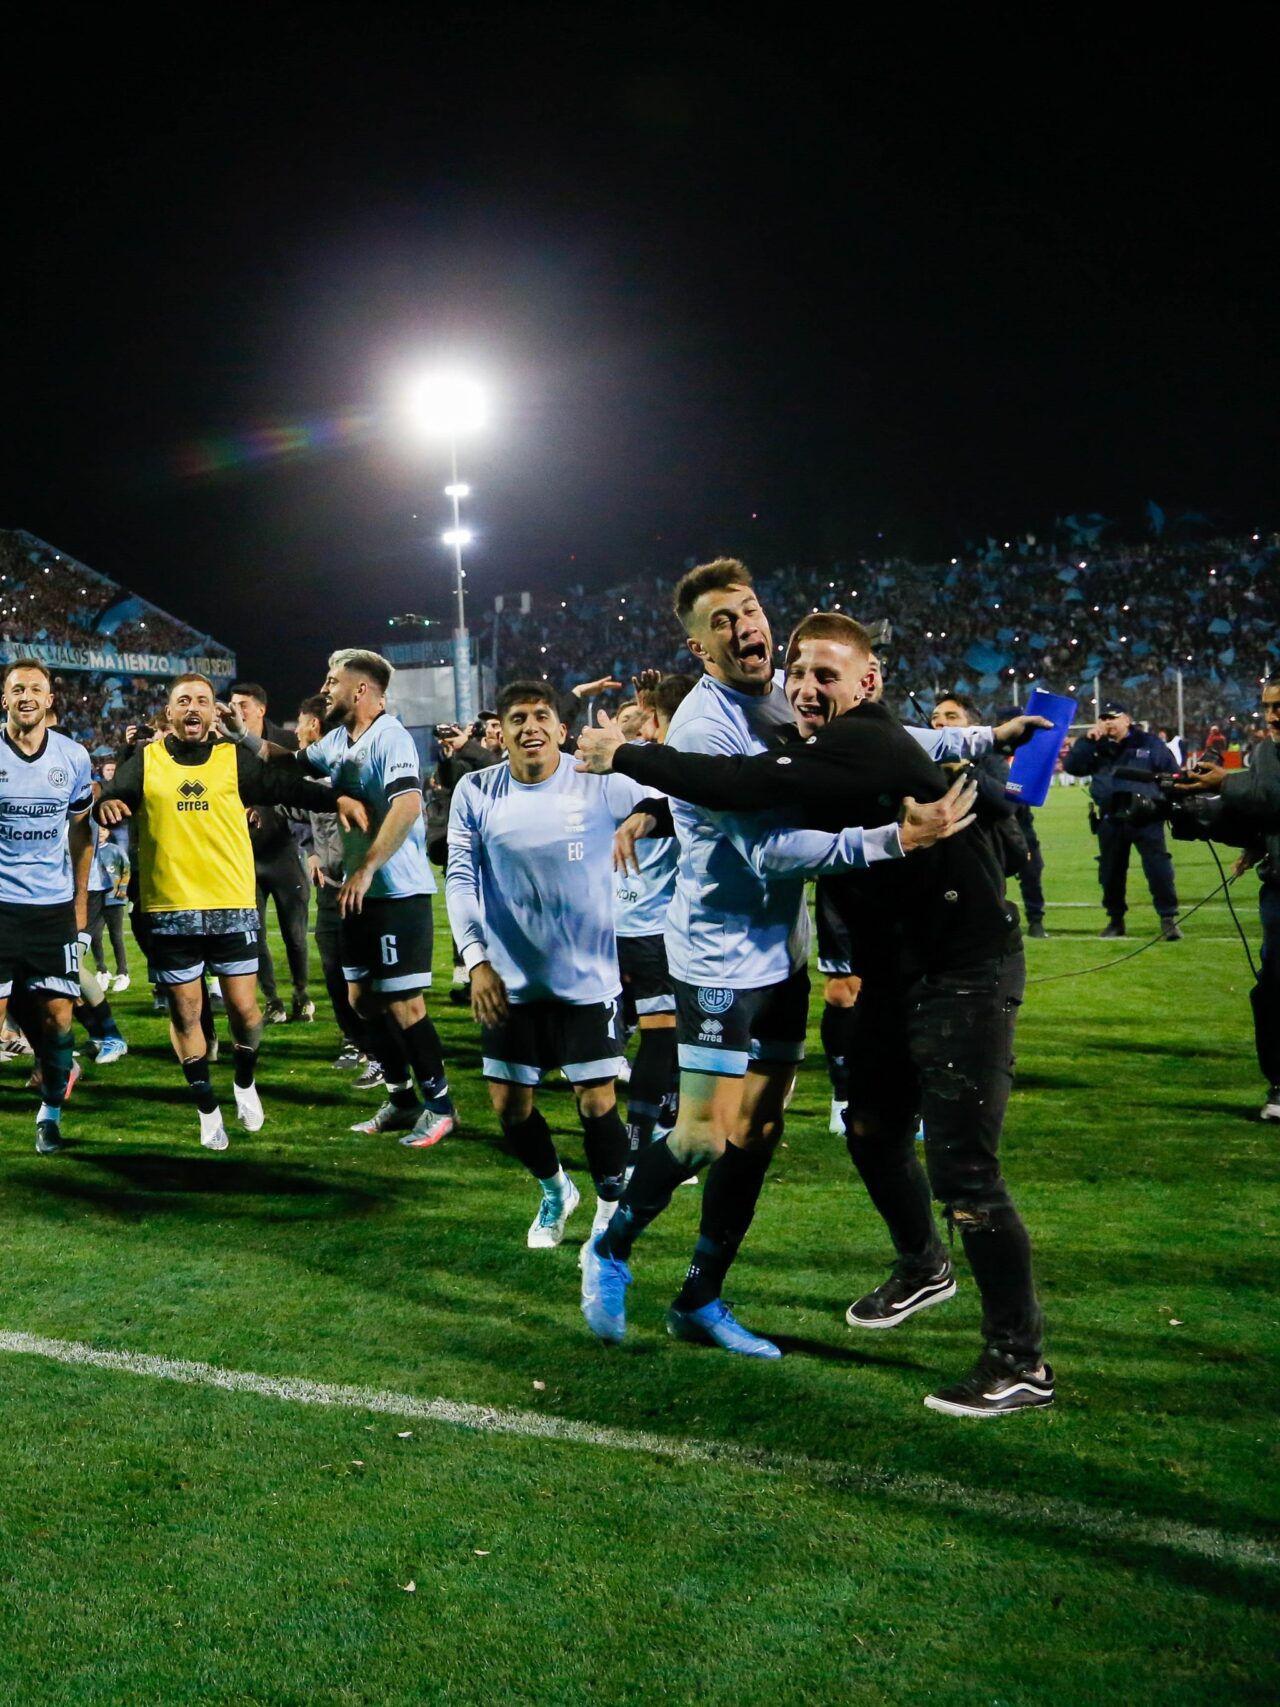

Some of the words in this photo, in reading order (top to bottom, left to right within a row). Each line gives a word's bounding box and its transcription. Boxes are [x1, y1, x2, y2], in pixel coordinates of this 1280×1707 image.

[1, 801, 58, 816] Tersuave
[176, 800, 209, 812] errea
[0, 825, 59, 841] Alcance
[567, 841, 584, 862] EC
[380, 933, 400, 967] 6
[697, 1032, 723, 1044] errea
